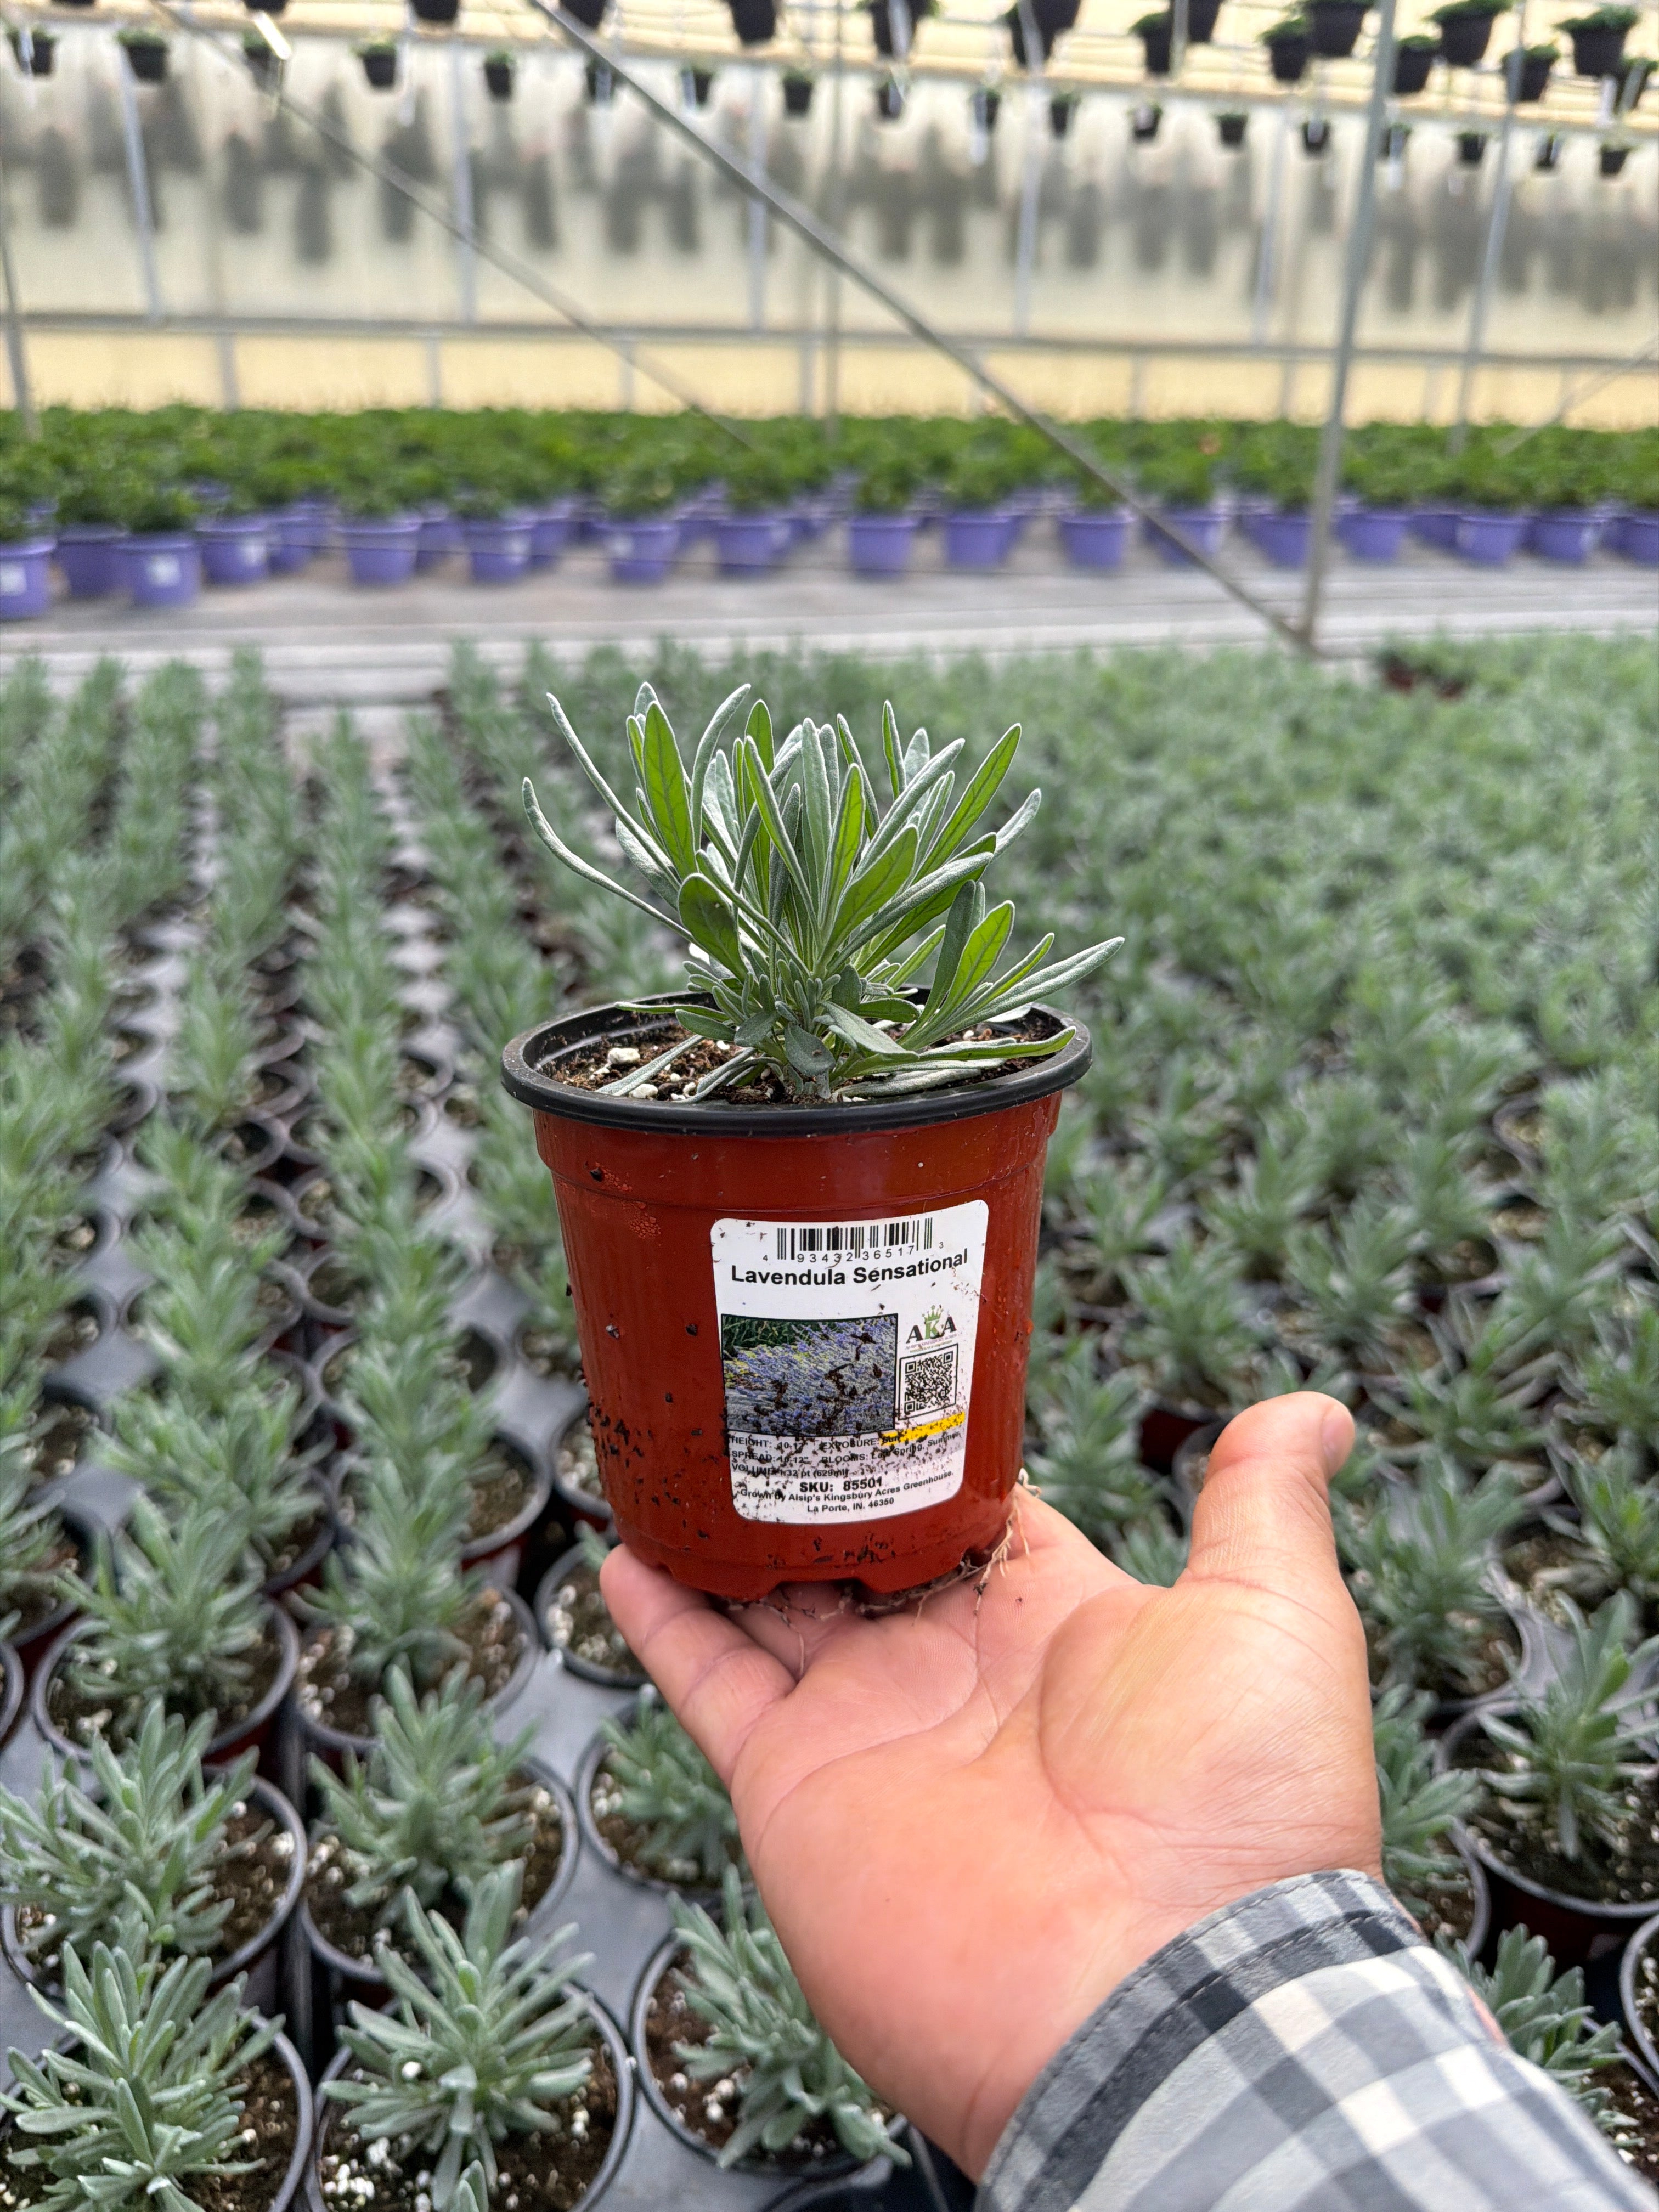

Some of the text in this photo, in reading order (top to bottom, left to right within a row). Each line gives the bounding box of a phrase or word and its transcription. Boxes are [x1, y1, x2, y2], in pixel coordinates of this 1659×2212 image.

[797, 1252, 853, 1262] 93432
[862, 1245, 915, 1261] 36517
[732, 1248, 967, 1285] Lavendula Sensational
[906, 1316, 957, 1344] AKA
[731, 1435, 772, 1448] HEIGHT:
[821, 1437, 879, 1449] EXPOSURE:
[732, 1450, 776, 1463] SPREAD:
[821, 1453, 868, 1463] BLOOMS:
[872, 1448, 892, 1459] La
[731, 1463, 778, 1475] VOLUME
[741, 1470, 953, 1503] Grown by Alsip's Kingsbury Acres Greenhouse.
[799, 1476, 882, 1493] SKU: 85501
[807, 1504, 819, 1513] La
[822, 1504, 850, 1513] Porte,
[868, 1497, 894, 1508] 46350
